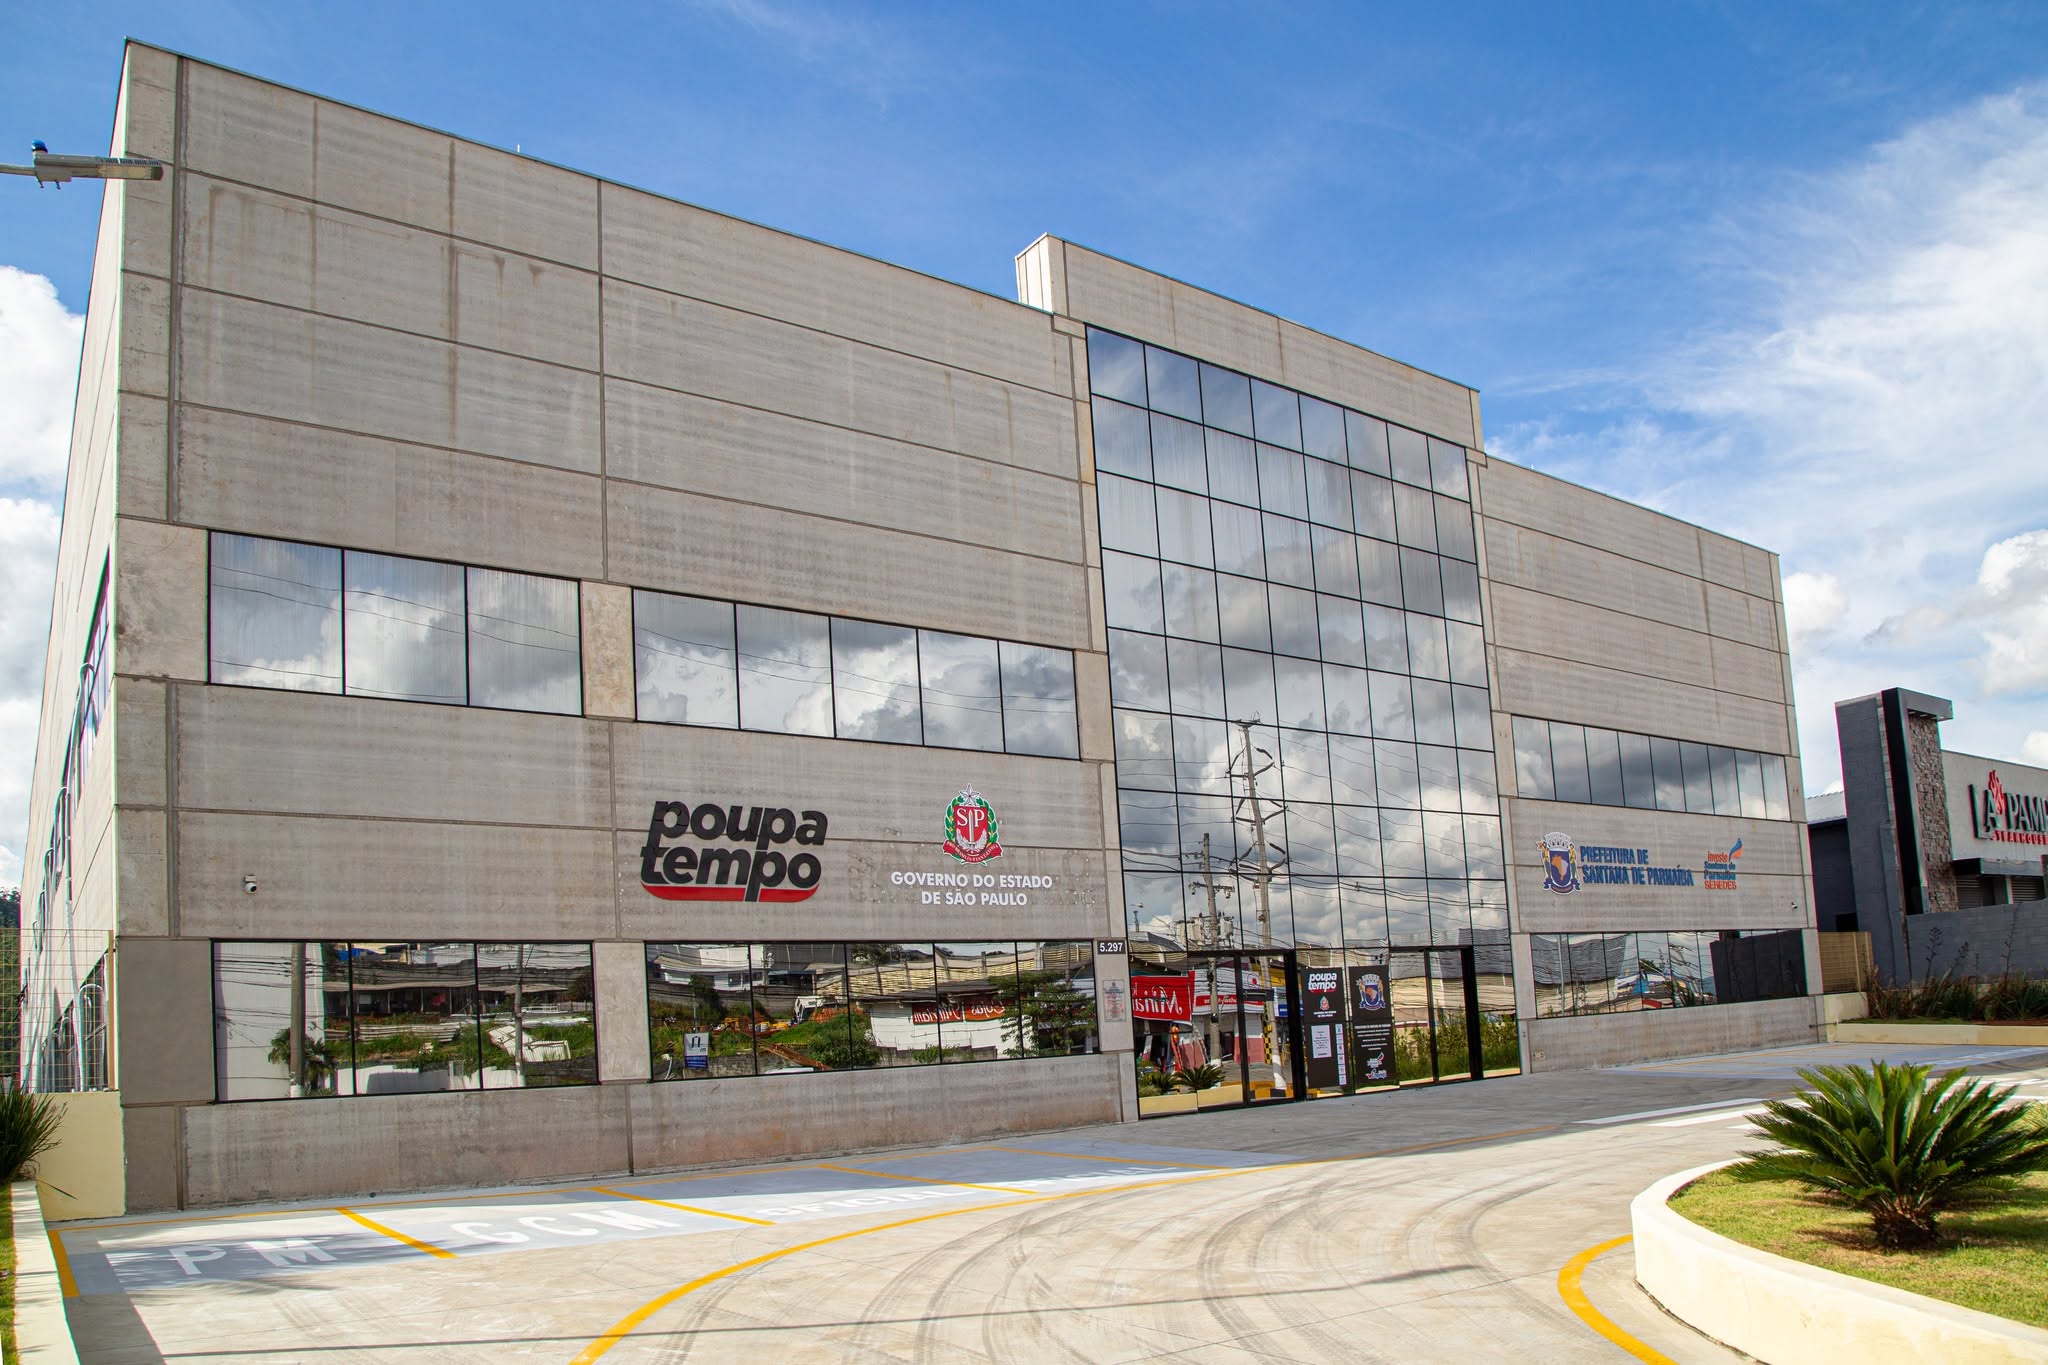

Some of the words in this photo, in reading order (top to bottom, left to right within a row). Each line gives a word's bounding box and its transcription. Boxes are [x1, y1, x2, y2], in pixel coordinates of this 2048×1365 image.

[646, 801, 828, 850] poupa
[1580, 846, 1636, 864] PREFEITURA
[1637, 849, 1649, 865] DE
[640, 846, 822, 902] tempo
[891, 871, 968, 888] GOVERNO
[973, 874, 995, 888] DO
[999, 875, 1053, 888] ESTADO
[1582, 865, 1630, 885] SANTANA
[1631, 867, 1646, 885] DE
[1647, 864, 1694, 887] PARNAÍBA
[921, 891, 941, 905] DE
[945, 888, 976, 906] SÃO
[981, 893, 1028, 906] PAULO
[1099, 942, 1123, 952] 5.297
[1309, 972, 1338, 982] poupa
[1308, 981, 1336, 993] tempo
